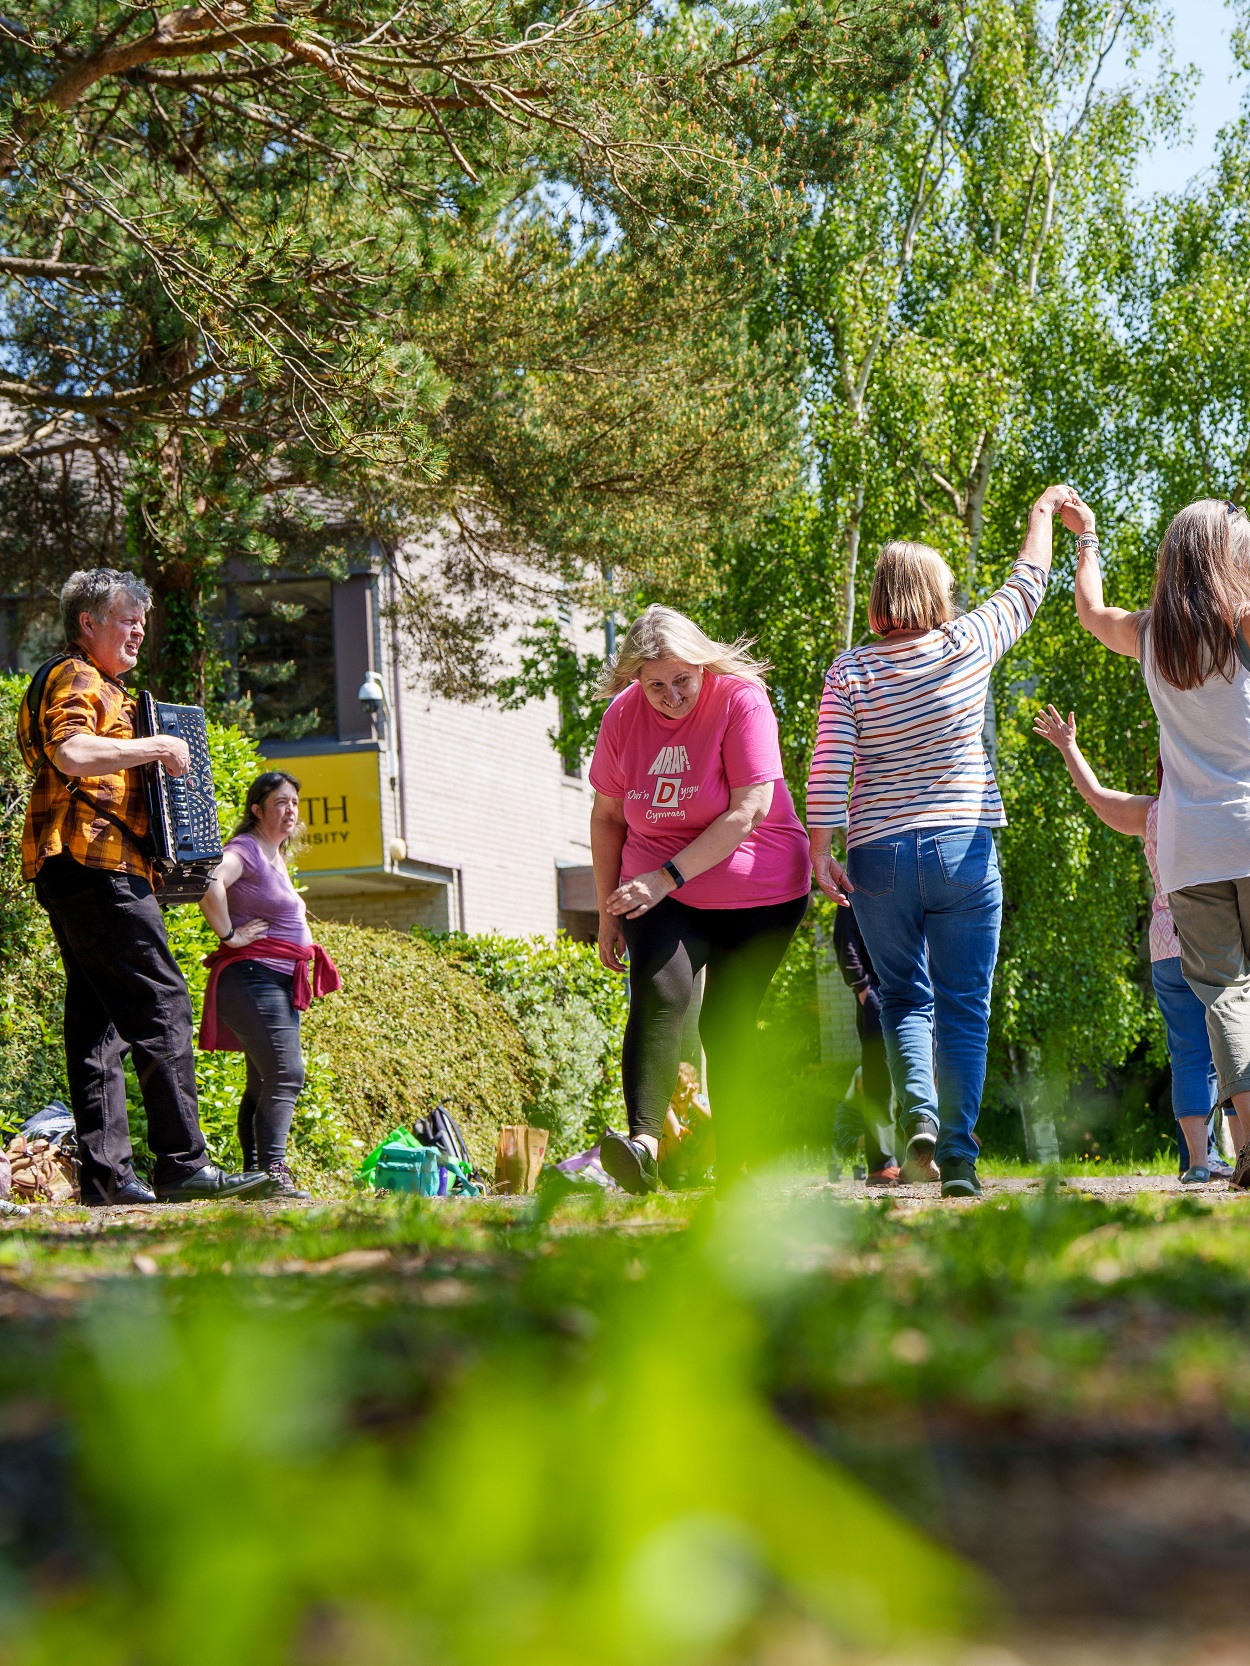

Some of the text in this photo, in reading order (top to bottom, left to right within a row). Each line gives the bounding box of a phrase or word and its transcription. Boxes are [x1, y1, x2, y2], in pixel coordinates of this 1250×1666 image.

[647, 745, 691, 775] ARAF!
[299, 795, 348, 825] TH
[645, 809, 686, 824] Cymraeg
[301, 831, 350, 845] RSITY
